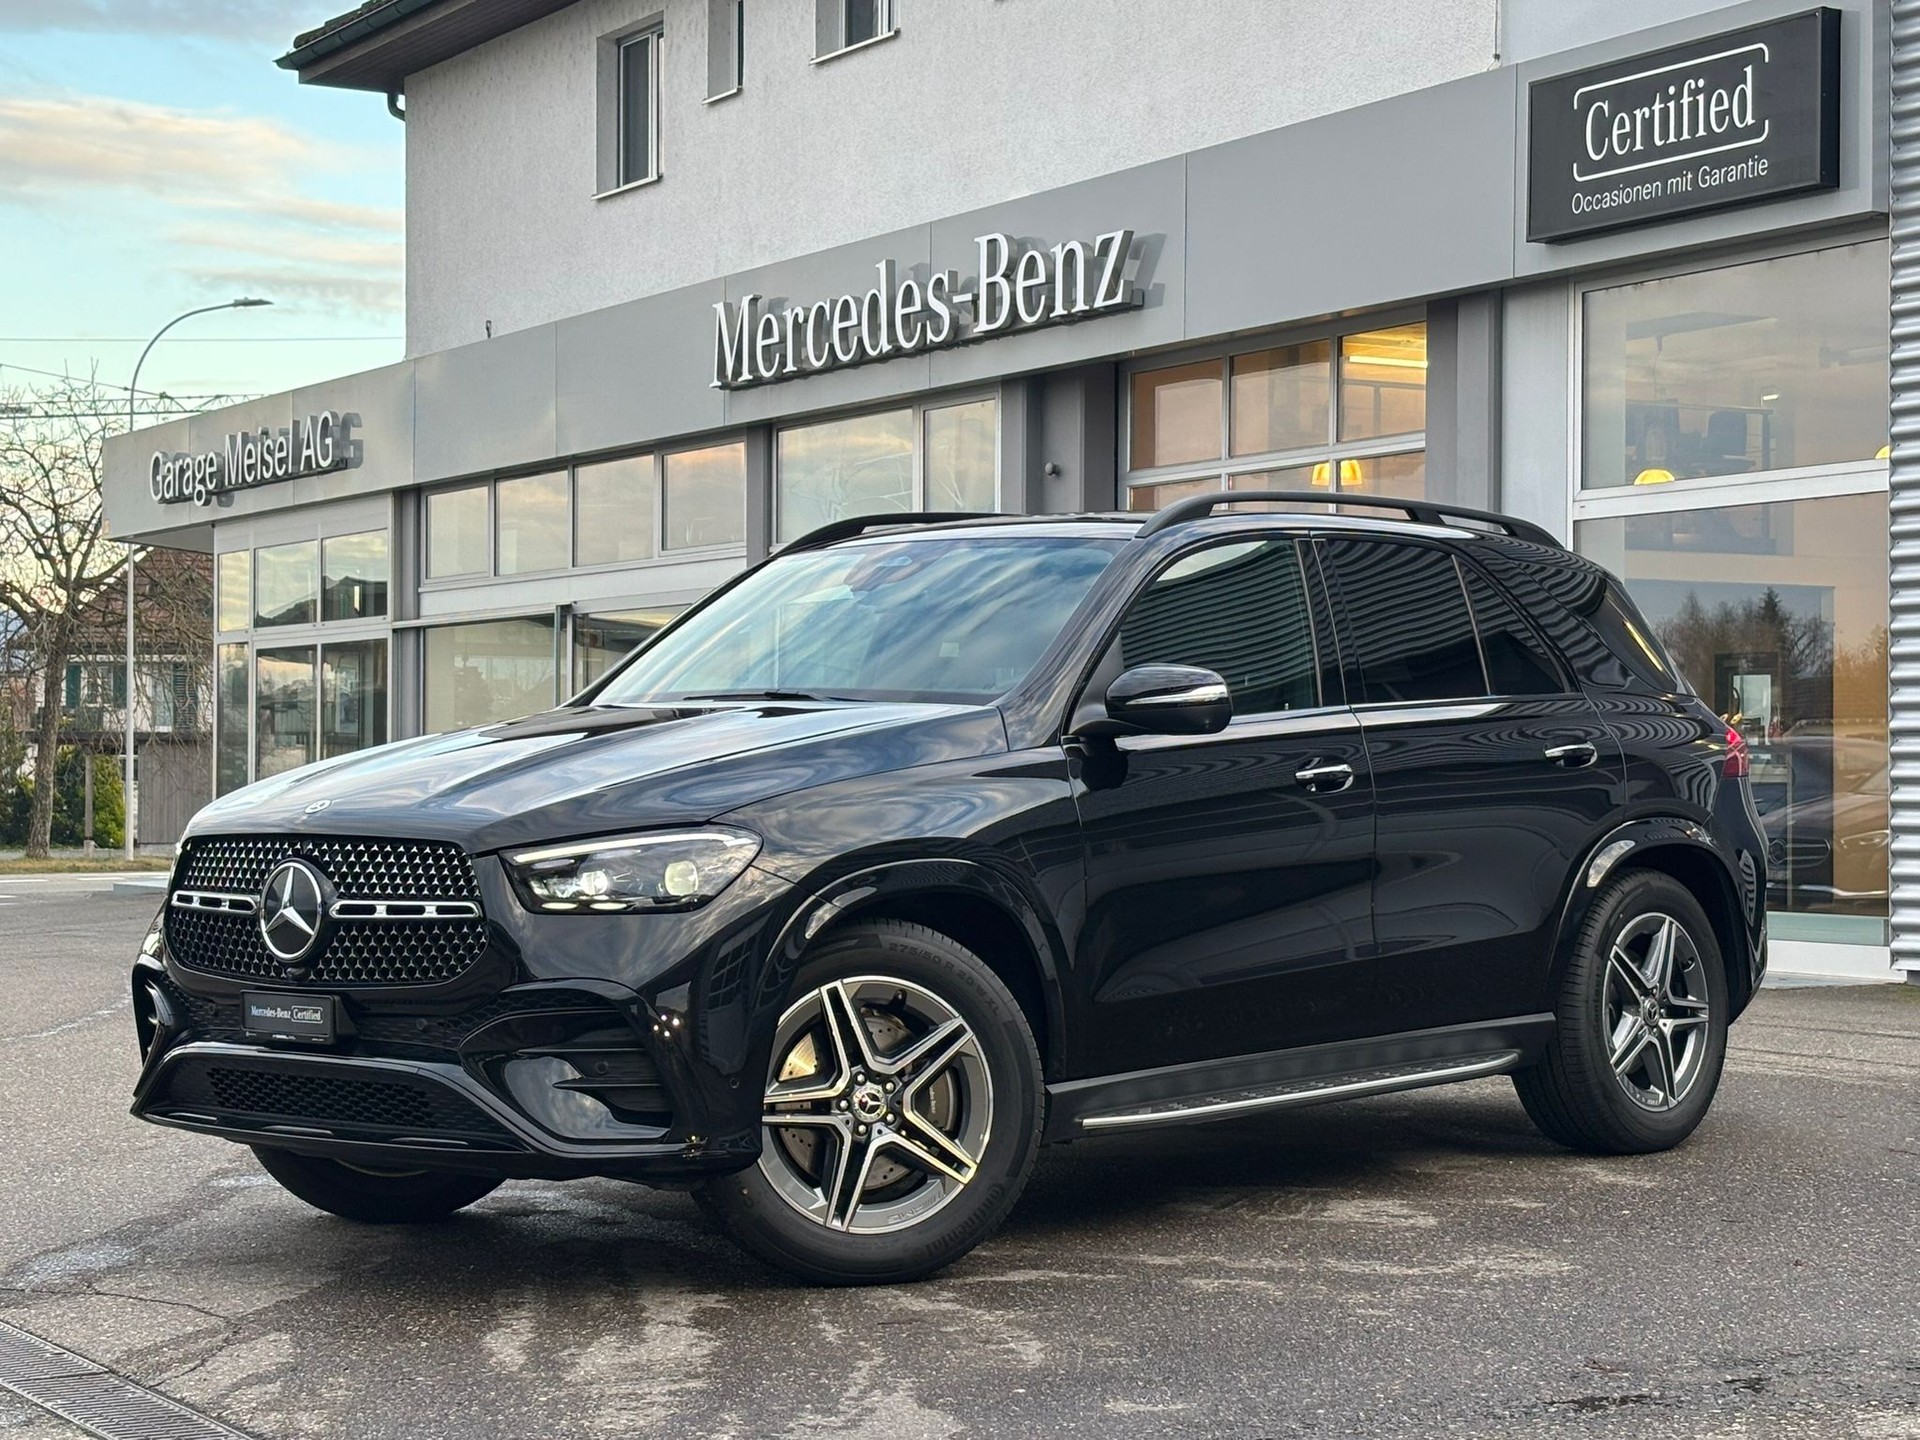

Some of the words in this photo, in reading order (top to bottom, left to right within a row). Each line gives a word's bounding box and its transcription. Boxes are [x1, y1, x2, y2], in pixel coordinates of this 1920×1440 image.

[1585, 64, 1756, 161] Certified
[1572, 180, 1661, 214] Occasionen
[1667, 171, 1692, 194] mit
[1698, 155, 1768, 188] Garantie
[710, 229, 1134, 388] Mercedes-Benz
[150, 451, 218, 506] Garage
[225, 419, 294, 486] Meisel
[300, 410, 335, 471] AG
[888, 942, 942, 964] 275/50
[945, 962, 954, 972] R
[250, 1004, 291, 1019] Mercedes-Benz
[293, 1008, 321, 1021] Certified
